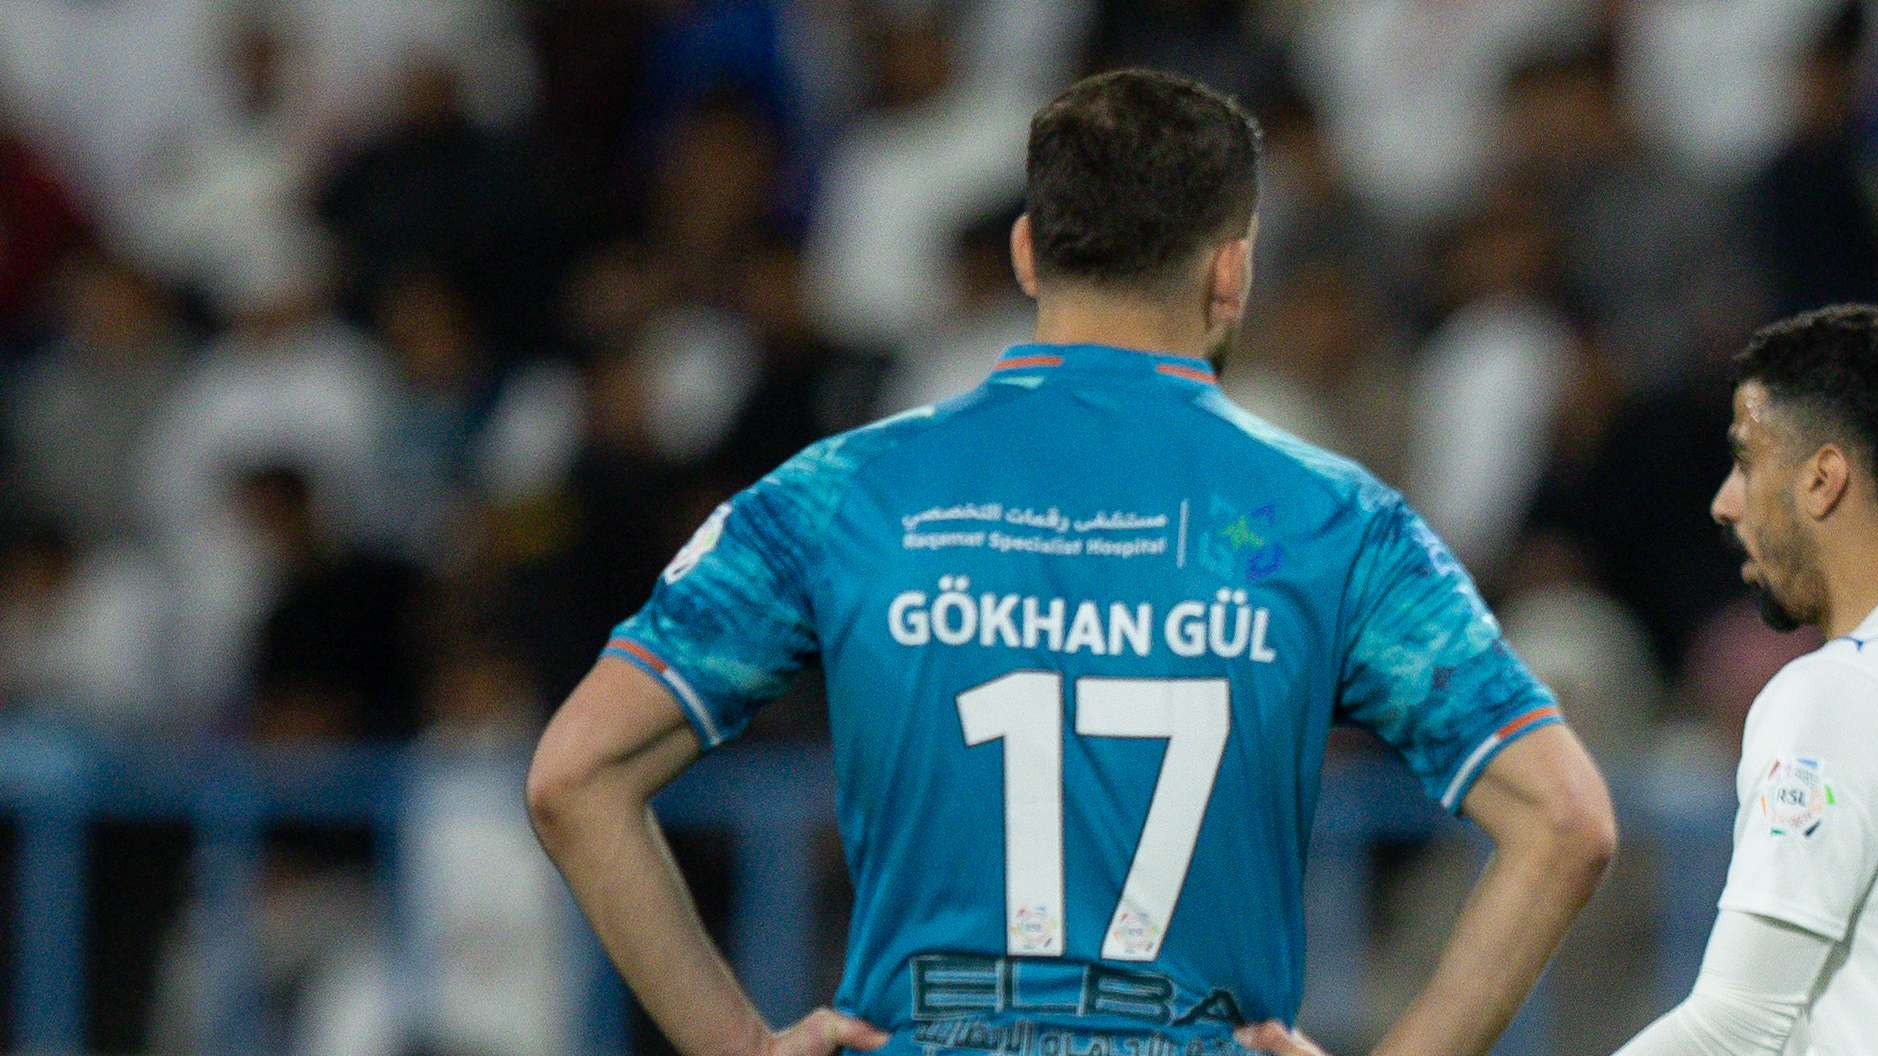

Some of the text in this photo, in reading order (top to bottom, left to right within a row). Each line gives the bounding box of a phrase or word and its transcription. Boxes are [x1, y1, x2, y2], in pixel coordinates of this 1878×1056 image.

[989, 531, 1083, 556] Specialist
[1086, 537, 1168, 558] Hospital
[888, 575, 1277, 664] GÖKHAN GÜL
[955, 668, 1231, 962] 17
[911, 955, 1248, 1029] ELBA
